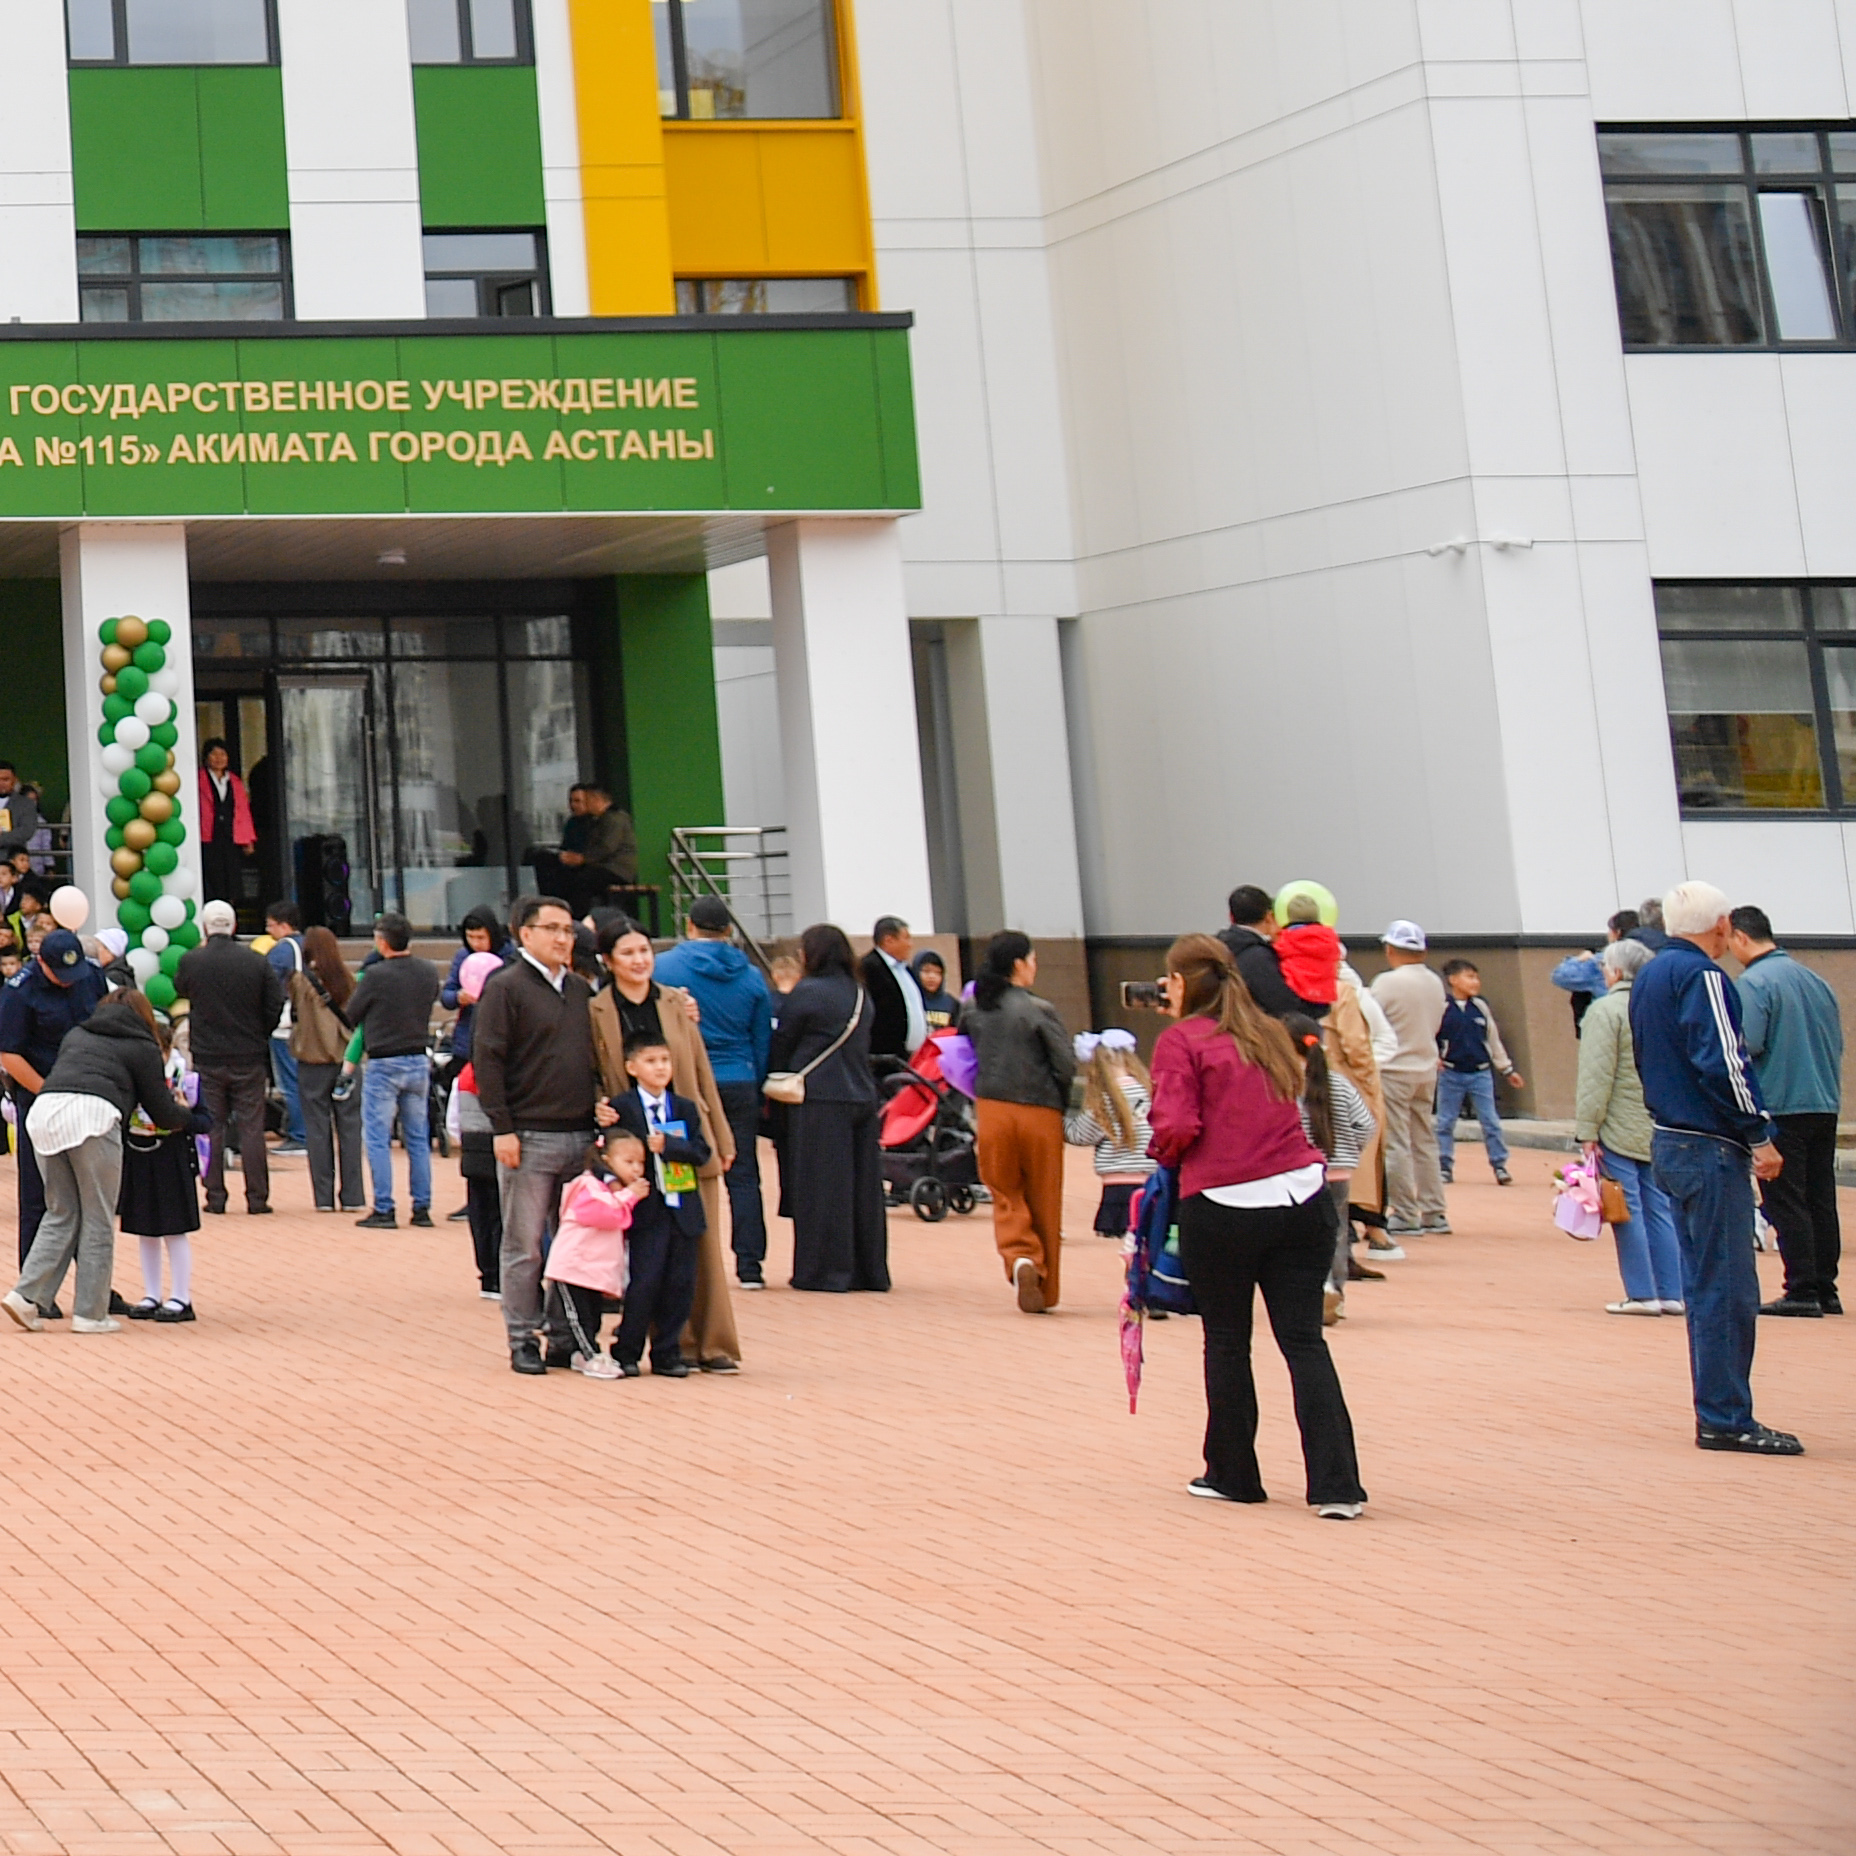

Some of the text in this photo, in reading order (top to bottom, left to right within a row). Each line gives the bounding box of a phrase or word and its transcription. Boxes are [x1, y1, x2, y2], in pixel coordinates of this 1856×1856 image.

[9, 379, 412, 420] ГОСУДАРСТВЕННОЕ
[421, 377, 699, 415] УЧРЕЖДЕНИЕ
[35, 434, 162, 467] №115»
[167, 432, 358, 465] АКИМАТА
[369, 430, 534, 467] ГОРОДА
[543, 429, 714, 462] АСТАНЫ
